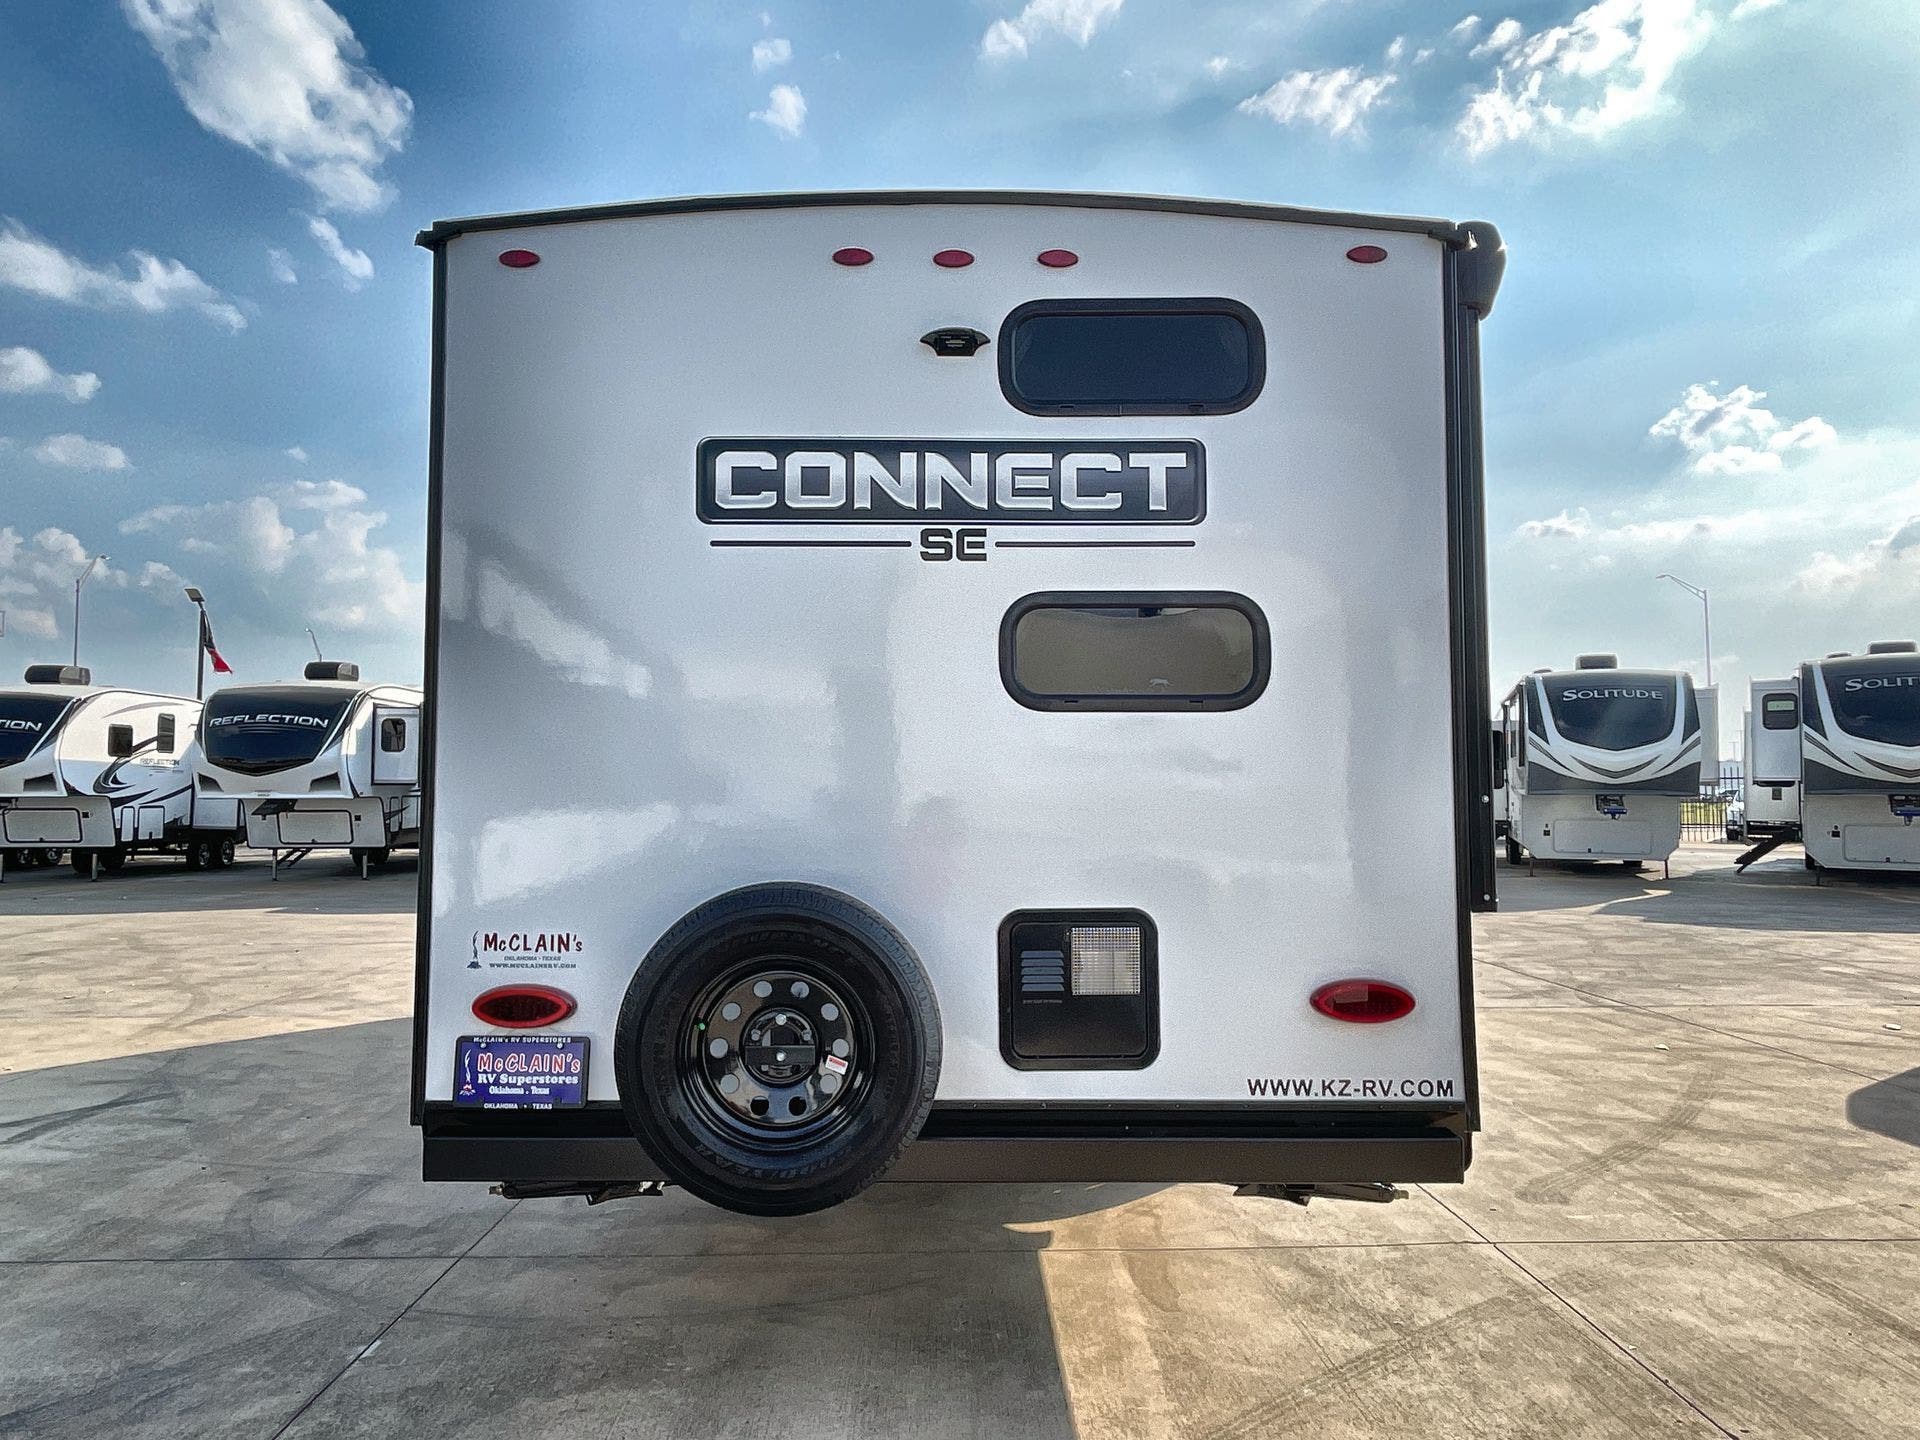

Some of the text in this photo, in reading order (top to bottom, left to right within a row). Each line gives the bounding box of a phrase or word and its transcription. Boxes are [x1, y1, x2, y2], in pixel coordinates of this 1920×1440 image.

[714, 450, 1188, 512] CONNECT
[919, 527, 988, 562] SE
[1845, 676, 1920, 691] SOLIT
[1562, 688, 1664, 701] SOLITUDE
[209, 714, 329, 728] REFLECTION
[483, 932, 583, 954] McCLAIN's
[477, 1053, 581, 1073] McCLAIN's
[478, 1074, 579, 1085] RV Superstores
[1247, 1078, 1454, 1098] WWW.KZ-RV.COM
[489, 1086, 524, 1094] Oklahoma
